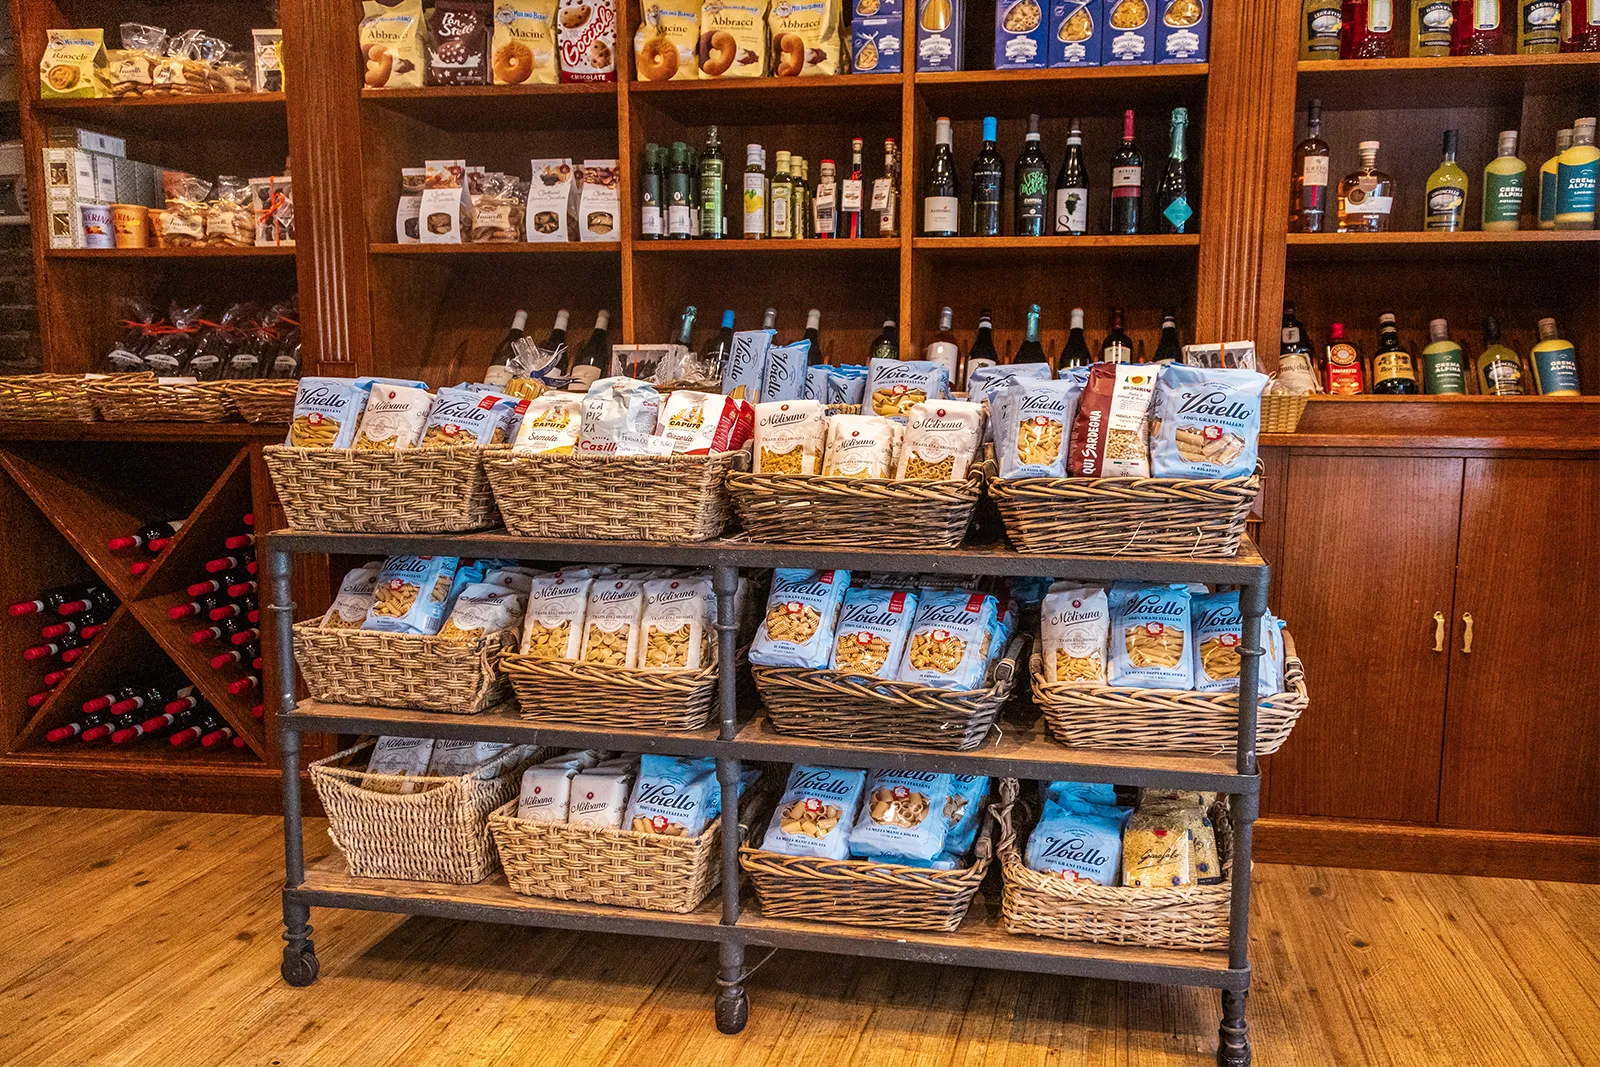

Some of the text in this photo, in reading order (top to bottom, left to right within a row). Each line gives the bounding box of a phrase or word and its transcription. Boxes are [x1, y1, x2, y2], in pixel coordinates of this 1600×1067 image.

[441, 13, 461, 28] Pan
[711, 17, 753, 27] Abbracci
[780, 18, 821, 28] Abbracci
[509, 27, 545, 40] Macine
[563, 7, 614, 67] Gocciole
[571, 74, 606, 82] CHOCOLATE
[729, 336, 753, 382] Voiello
[767, 353, 789, 401] Voiello
[296, 386, 349, 408] Voiello
[1019, 395, 1066, 412] Voiello
[367, 400, 412, 413] Molisana
[432, 398, 489, 421] Voiello
[589, 402, 604, 410] LA
[1176, 391, 1254, 420] Voiello
[669, 420, 702, 429] CAPUTO
[759, 411, 809, 428] Molisana
[912, 416, 966, 432] Molisana
[1218, 420, 1245, 428] ITALIANI
[581, 440, 618, 452] Casill
[835, 438, 878, 453] Molisana
[1081, 410, 1102, 476] QUI SARDEGNA
[382, 555, 430, 573] Voiello
[533, 585, 581, 601] Molisana
[773, 578, 830, 597] Voiello
[591, 590, 640, 604] Molisana
[648, 589, 698, 605] Molisana
[1123, 594, 1186, 617] Voiello
[841, 604, 901, 627] Voiello
[918, 604, 978, 626] Voiello
[1051, 610, 1103, 627] Molisana
[1197, 606, 1243, 631] Voiel
[378, 738, 422, 751] Molisana
[789, 770, 853, 795] Voiello
[873, 769, 940, 783] Voiello
[905, 781, 931, 789] ITALIANI
[519, 795, 556, 809] Molisana
[636, 782, 700, 811] Voiello
[820, 794, 844, 802] ITALIANI
[570, 801, 609, 816] Molisana
[1041, 836, 1110, 866] Voiello
[1136, 848, 1185, 866] Garofalo
[1057, 860, 1078, 868] GRANI
[1078, 864, 1102, 874] ITALIANI
